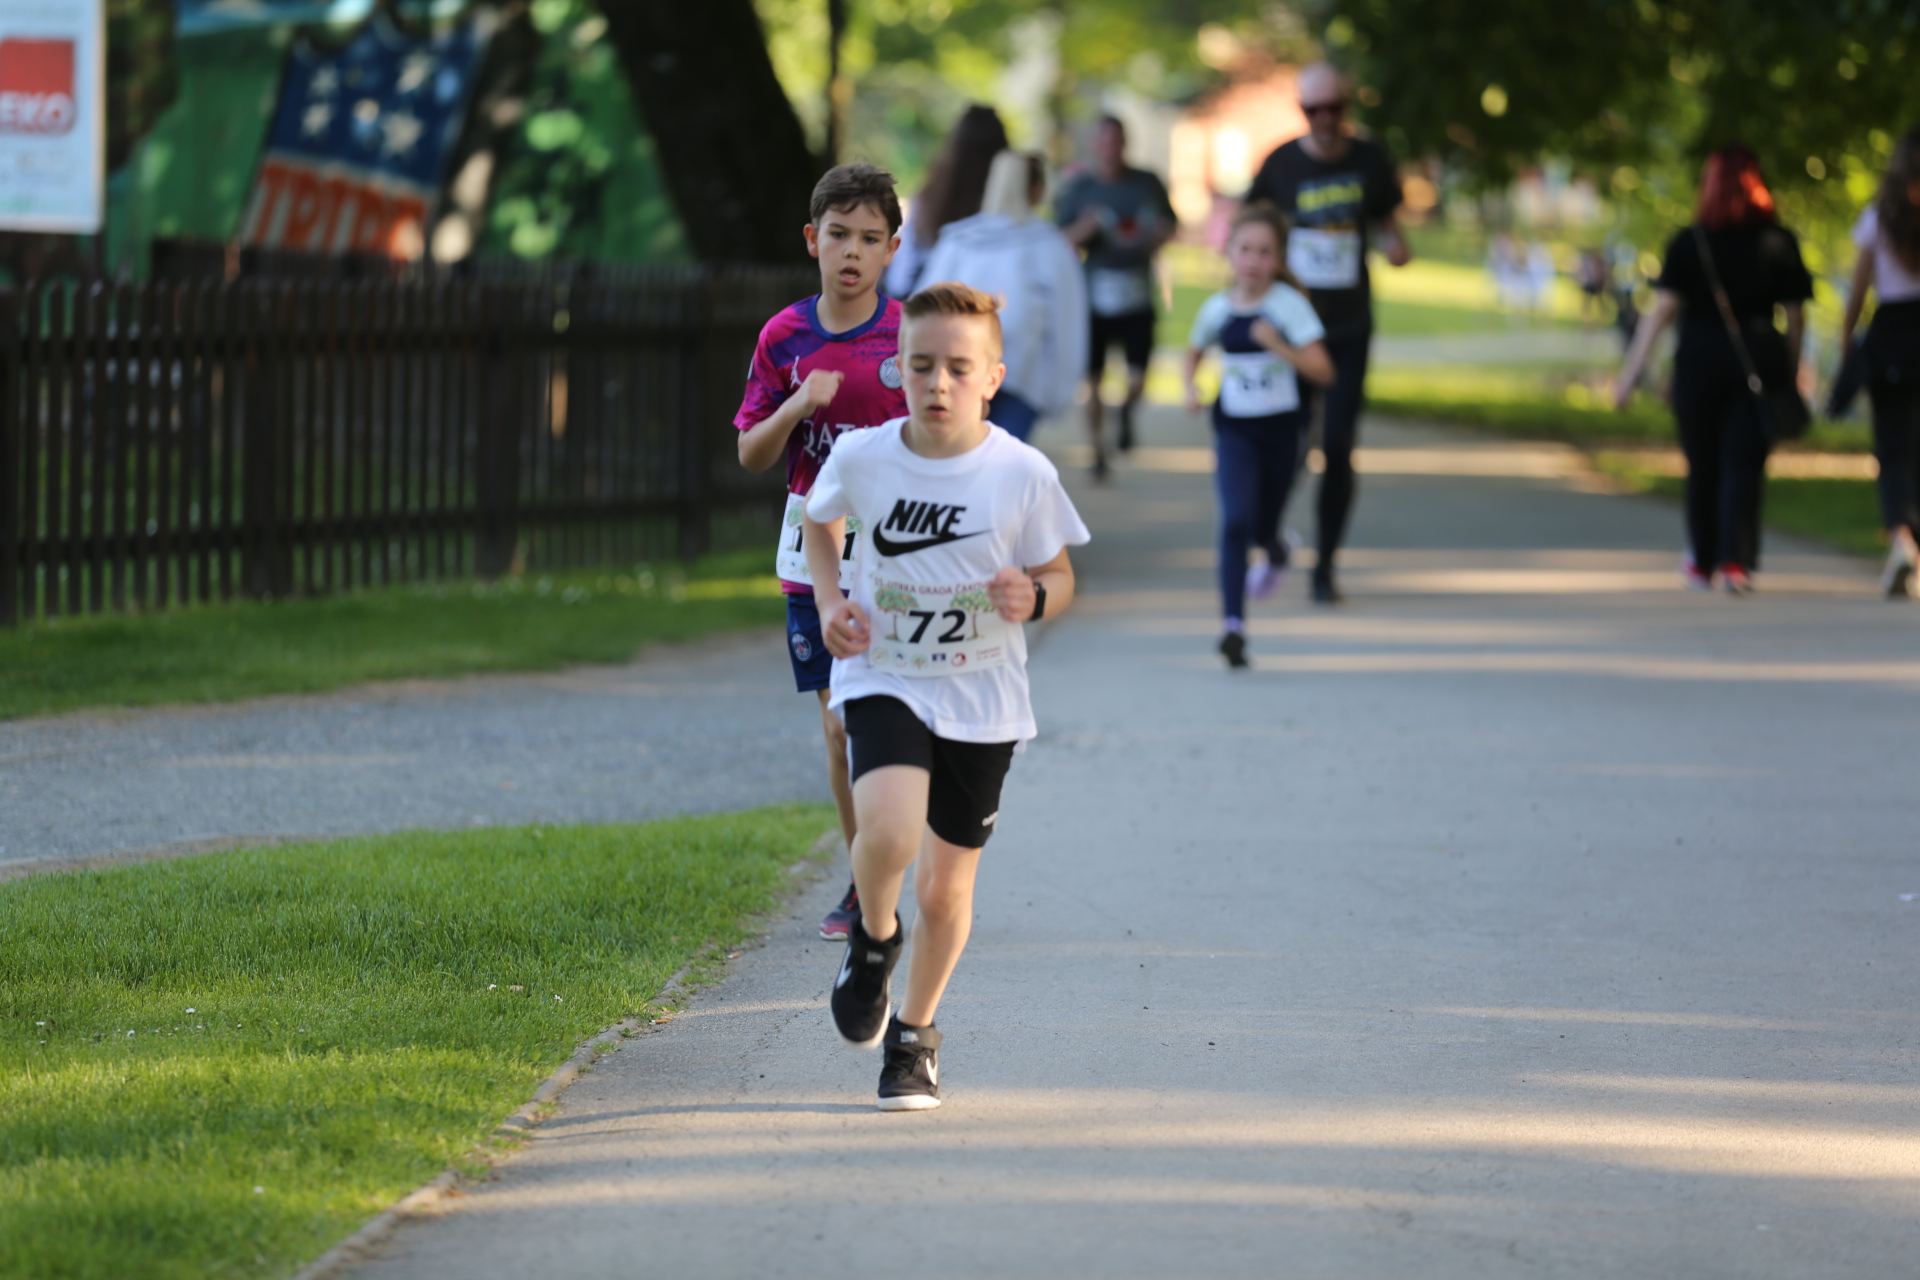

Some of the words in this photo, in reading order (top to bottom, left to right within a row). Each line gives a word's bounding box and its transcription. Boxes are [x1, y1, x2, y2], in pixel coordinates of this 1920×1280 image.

[884, 499, 967, 538] NIKE
[795, 525, 856, 561] 11
[918, 584, 952, 595] GRADA
[908, 609, 967, 644] 72
